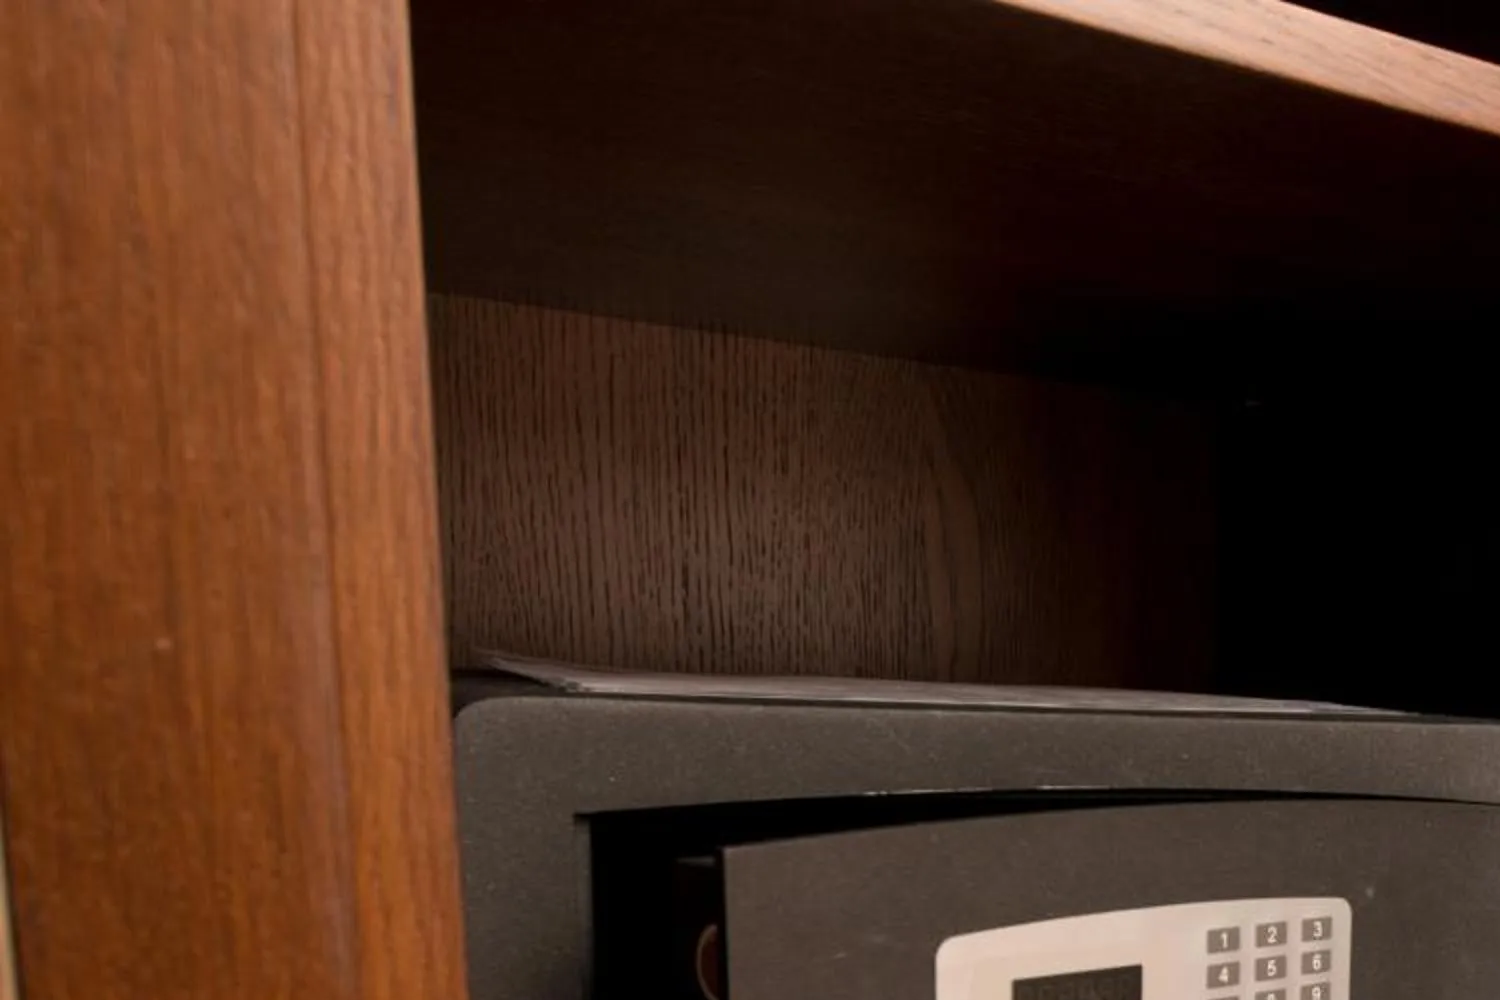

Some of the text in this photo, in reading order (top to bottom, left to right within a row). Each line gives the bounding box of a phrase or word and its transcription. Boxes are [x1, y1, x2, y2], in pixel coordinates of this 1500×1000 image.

[1221, 921, 1323, 948] 1 2 3
[1218, 954, 1321, 983] 4 5 6
